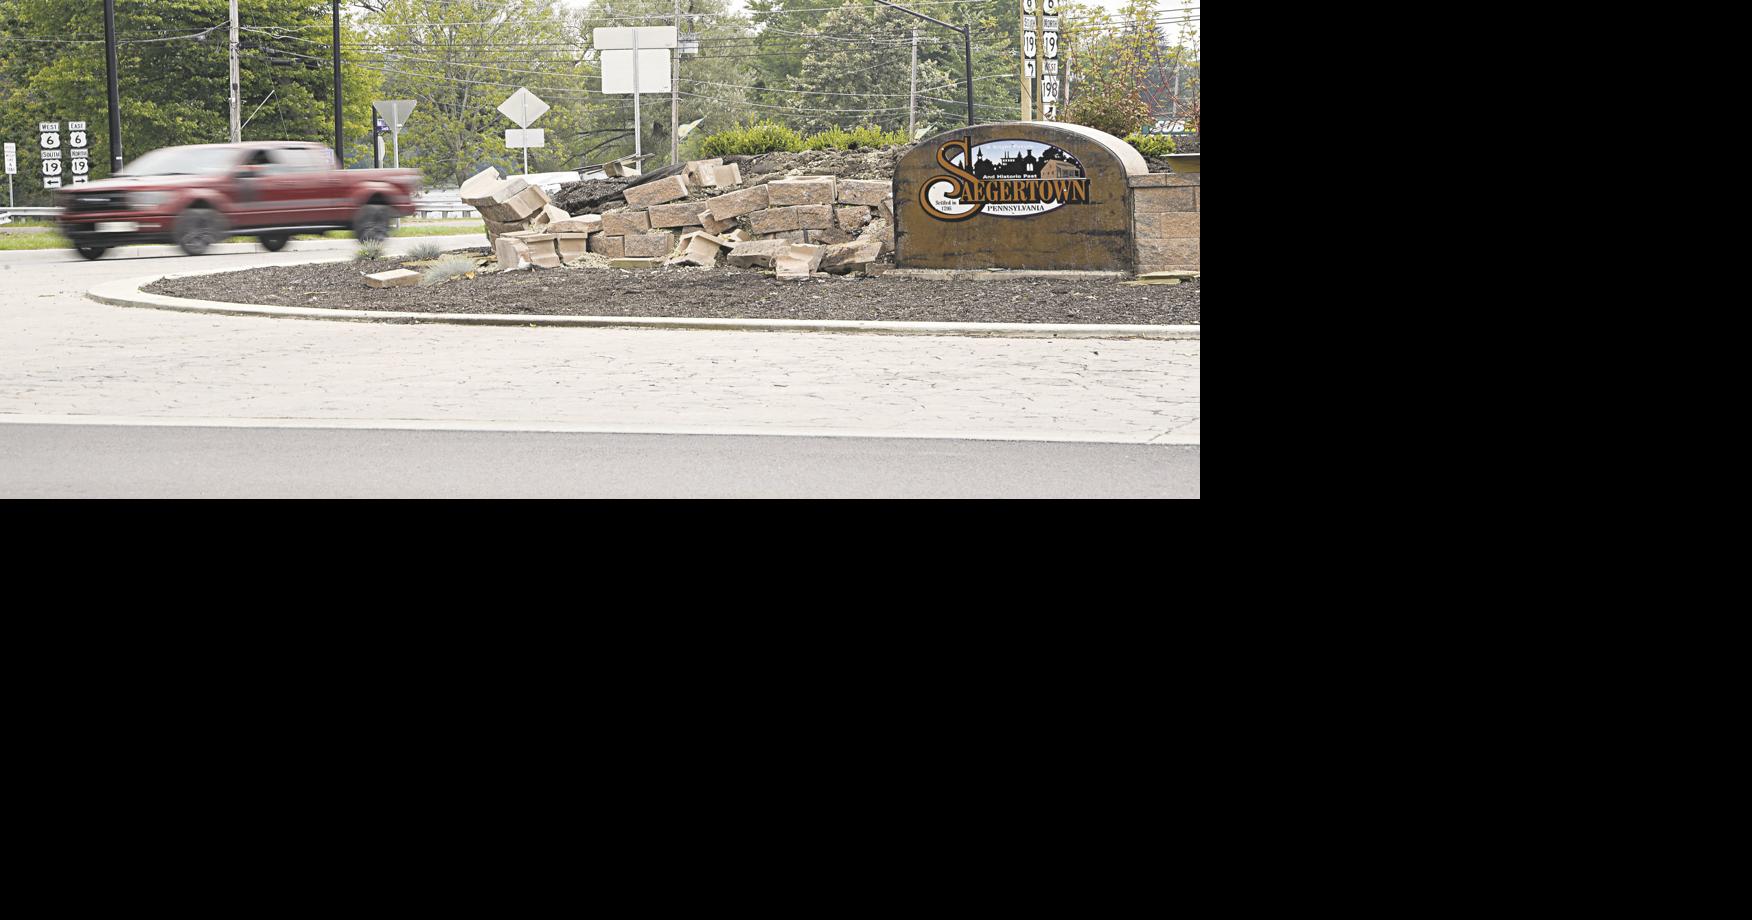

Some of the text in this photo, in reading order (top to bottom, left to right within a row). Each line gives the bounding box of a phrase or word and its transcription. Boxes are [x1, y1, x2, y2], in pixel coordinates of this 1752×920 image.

[1026, 36, 1034, 52] 19
[1045, 37, 1055, 52] 19
[1043, 82, 1058, 98] 198
[46, 135, 54, 145] 6
[75, 134, 81, 144] 6
[45, 162, 58, 172] 19
[74, 161, 86, 171] 19
[919, 137, 1088, 221] SAEGERTOWN
[987, 204, 1045, 212] PENNSYLVANIA
